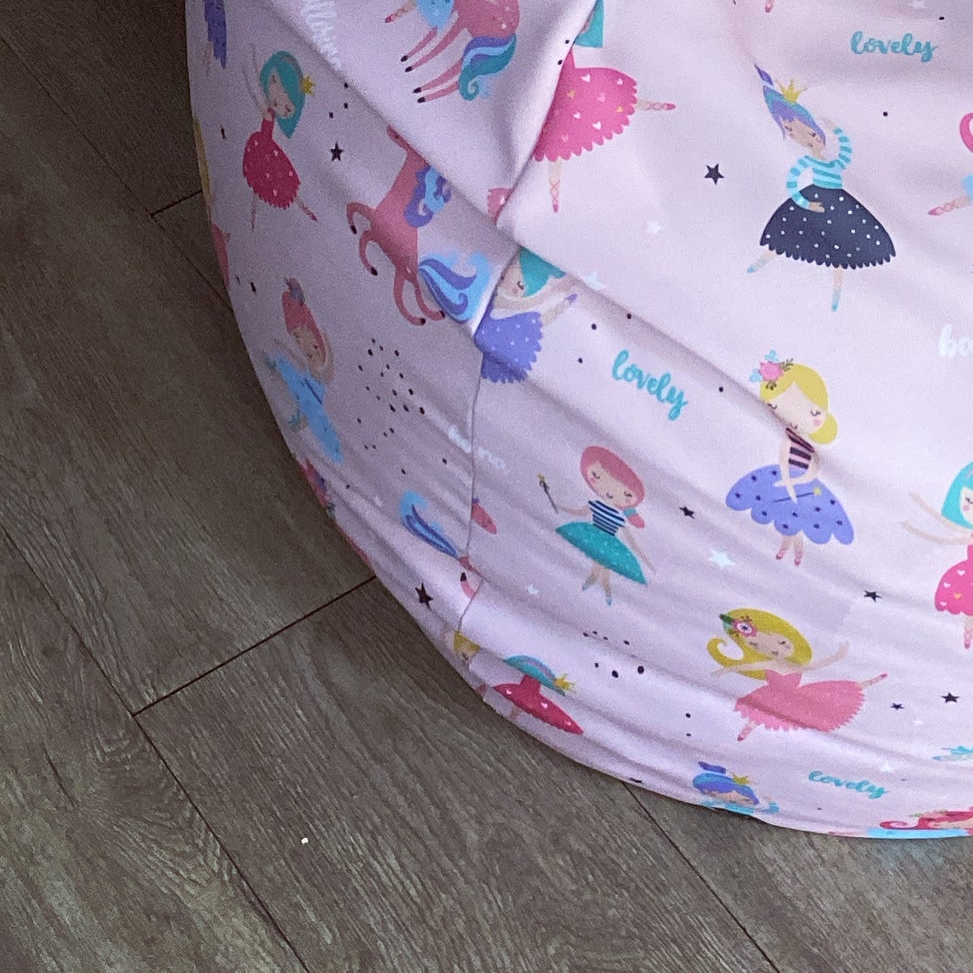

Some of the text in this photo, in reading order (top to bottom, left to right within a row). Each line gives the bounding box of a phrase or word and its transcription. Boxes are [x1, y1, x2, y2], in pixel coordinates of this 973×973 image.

[850, 30, 939, 63] lovely
[612, 349, 688, 421] lovely
[808, 770, 889, 800] lovely
